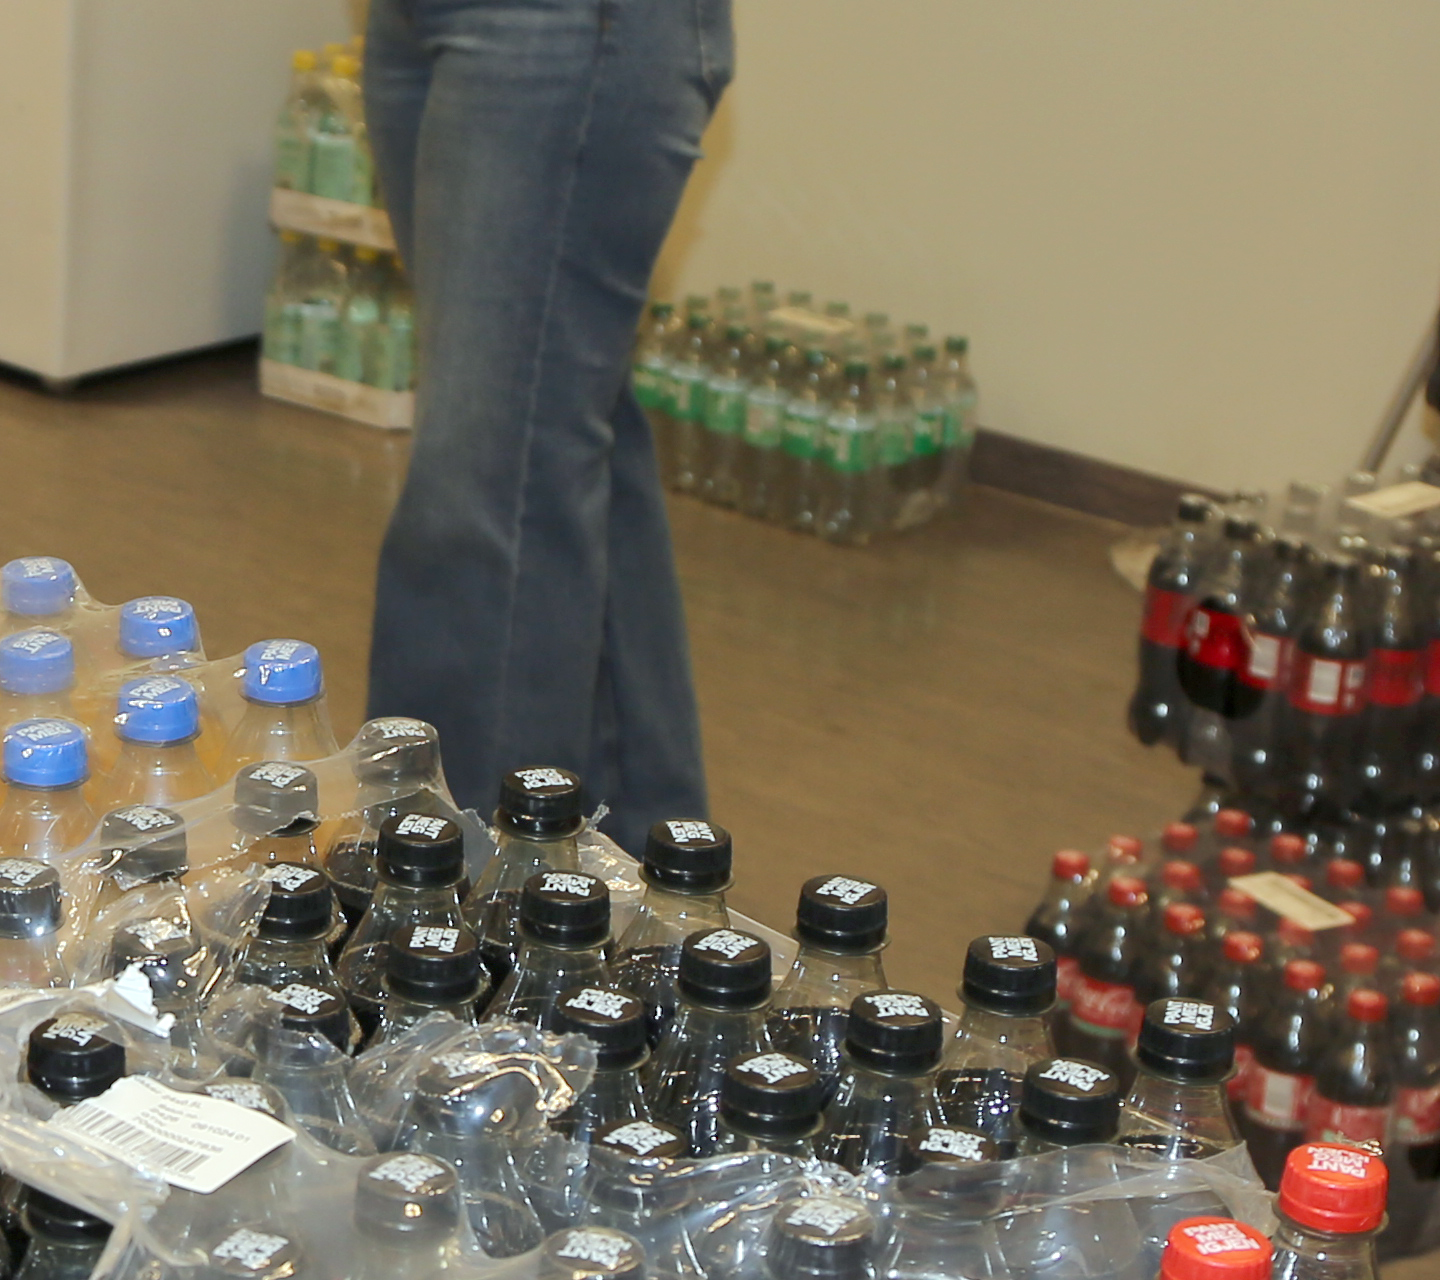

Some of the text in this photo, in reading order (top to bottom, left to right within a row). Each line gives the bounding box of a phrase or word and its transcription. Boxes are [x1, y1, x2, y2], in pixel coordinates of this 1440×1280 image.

[409, 926, 431, 948] PANT
[425, 927, 444, 947] MEG
[438, 928, 460, 952] IGJEN
[988, 936, 1008, 959] PANT
[1005, 937, 1022, 957] MEG
[1021, 937, 1039, 961] IGJEN
[1164, 1000, 1182, 1024] PANT
[1180, 1001, 1199, 1023] MEG
[1195, 1003, 1215, 1031] IGJEN
